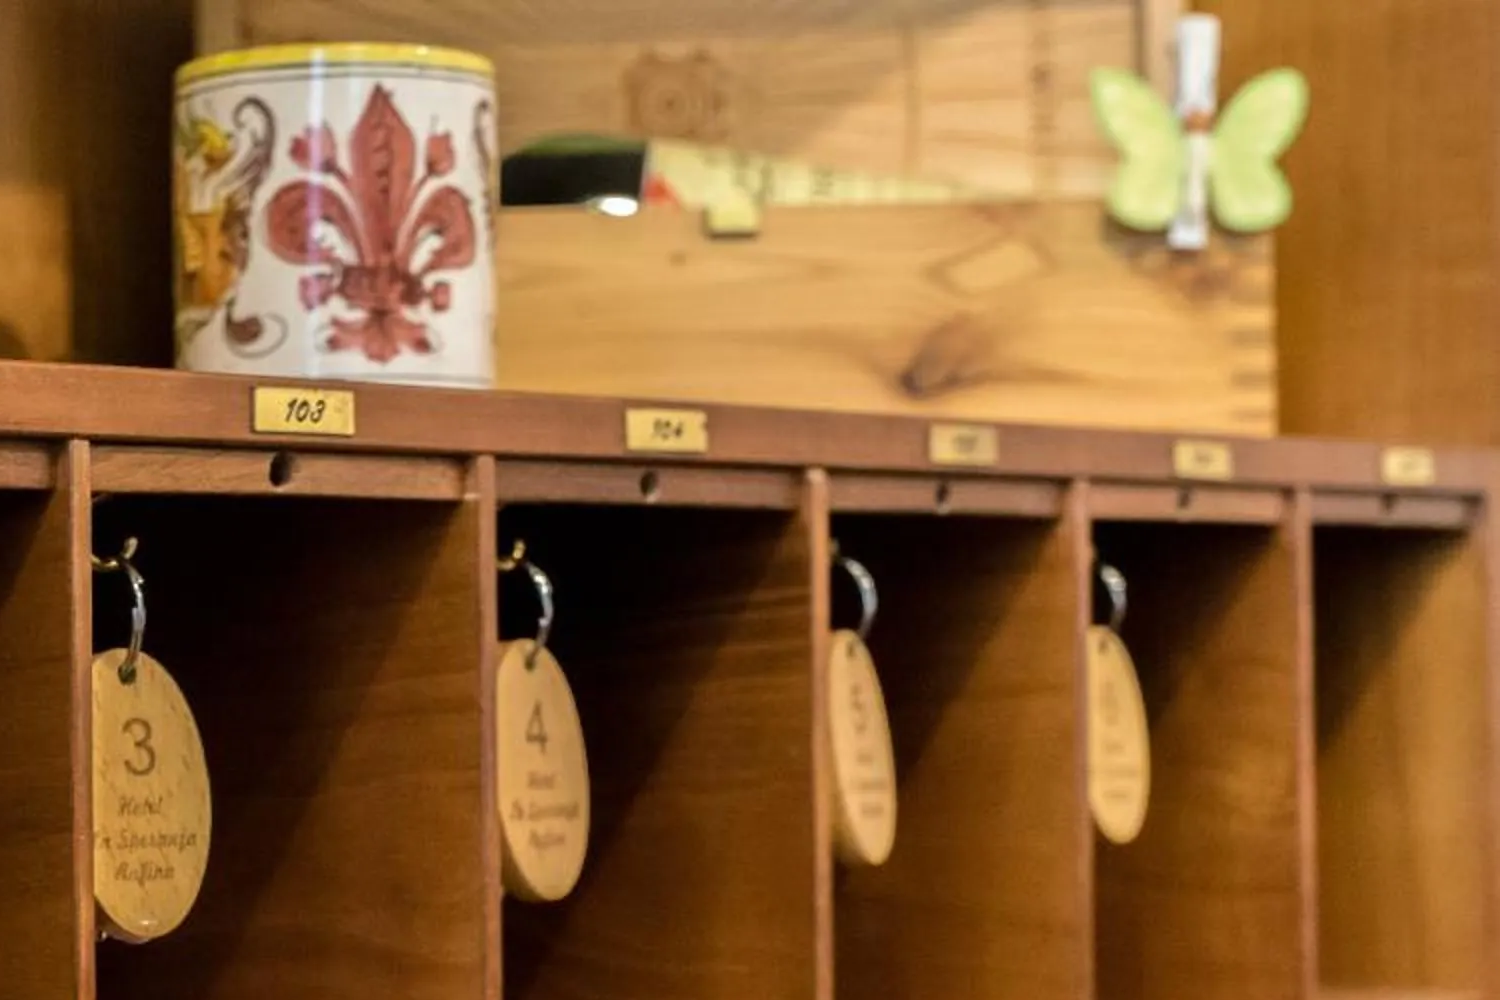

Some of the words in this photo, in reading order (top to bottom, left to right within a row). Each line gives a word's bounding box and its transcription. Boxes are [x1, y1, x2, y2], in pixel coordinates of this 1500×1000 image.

[284, 398, 326, 424] 103
[122, 717, 156, 777] 3
[525, 699, 548, 754] 4
